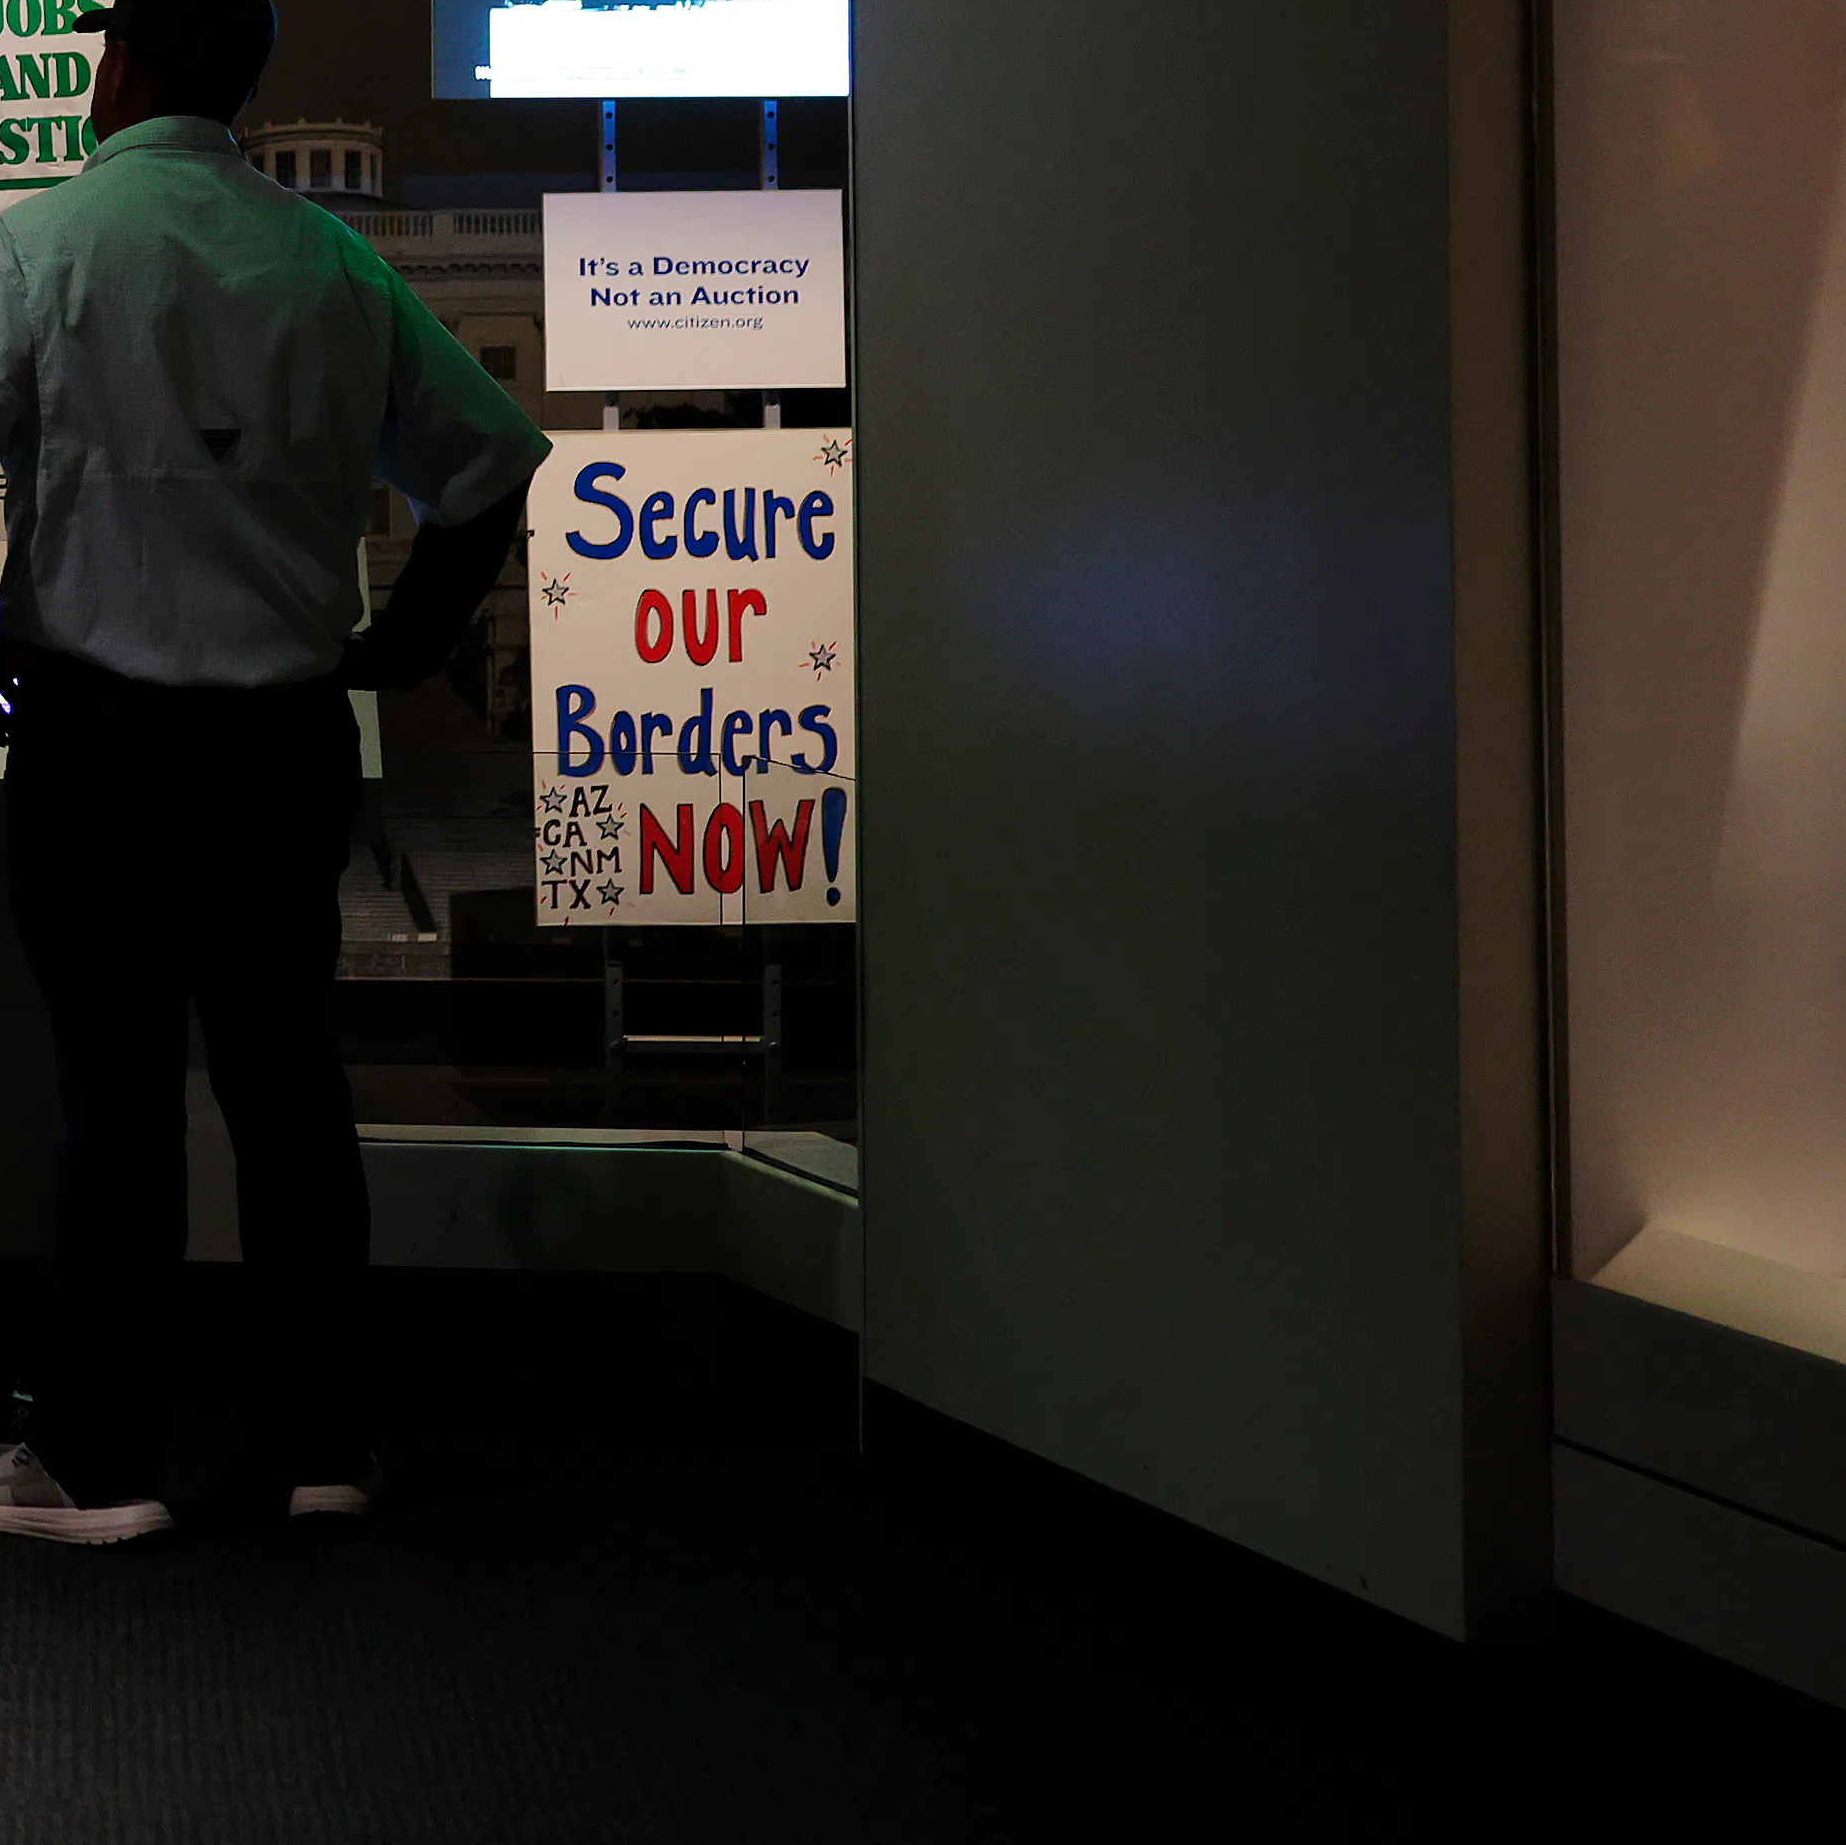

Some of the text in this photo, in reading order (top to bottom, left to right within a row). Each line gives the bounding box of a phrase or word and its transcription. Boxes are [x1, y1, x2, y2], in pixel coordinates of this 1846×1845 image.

[627, 262, 645, 277] a
[652, 255, 810, 283] Democracy
[590, 286, 800, 308] Not an Auction
[626, 315, 764, 332] www.citizen.org
[565, 461, 836, 563] Secure
[634, 588, 768, 667] our
[555, 684, 838, 779] Borders
[568, 784, 611, 819] AZ
[541, 820, 587, 848] CA
[638, 786, 848, 908] NOW!
[570, 846, 622, 877] NM
[541, 879, 591, 910] TX
